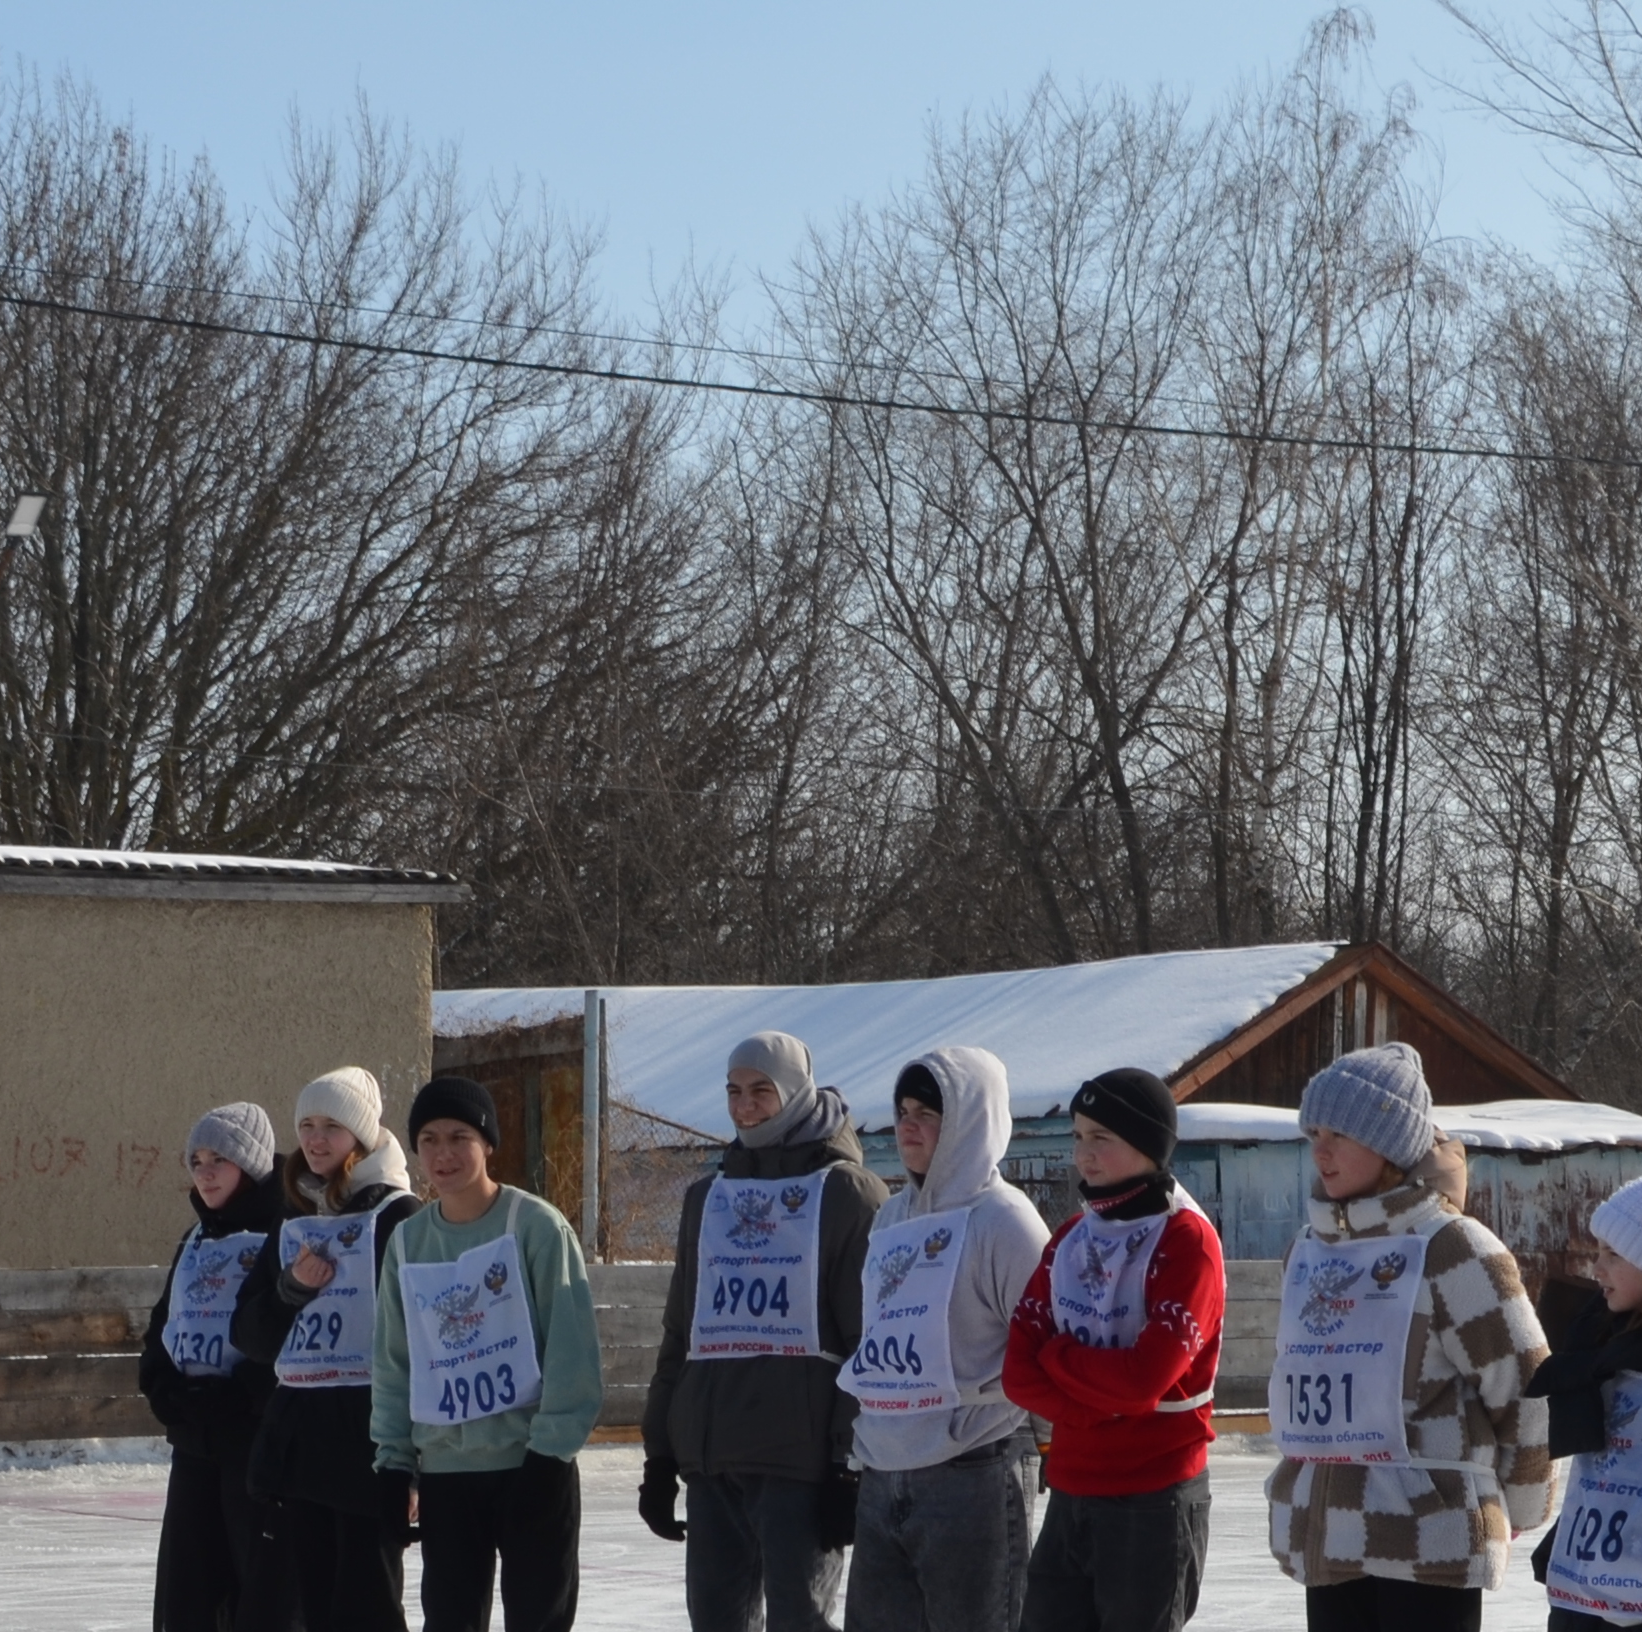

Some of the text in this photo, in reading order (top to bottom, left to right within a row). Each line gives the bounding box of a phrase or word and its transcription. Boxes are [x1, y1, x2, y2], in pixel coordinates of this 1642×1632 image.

[1312, 1258, 1355, 1274] ЛЫЖНЯ
[713, 1276, 790, 1318] 4904
[1329, 1300, 1355, 1309] 2015
[761, 1324, 803, 1336] область
[732, 1343, 773, 1353] РОССИИ
[783, 1345, 806, 1355] 2014
[438, 1363, 516, 1420] 4903
[918, 1395, 942, 1408] 2014
[1286, 1373, 1353, 1426] 1531
[1336, 1430, 1385, 1443] область
[1591, 1573, 1642, 1589] область
